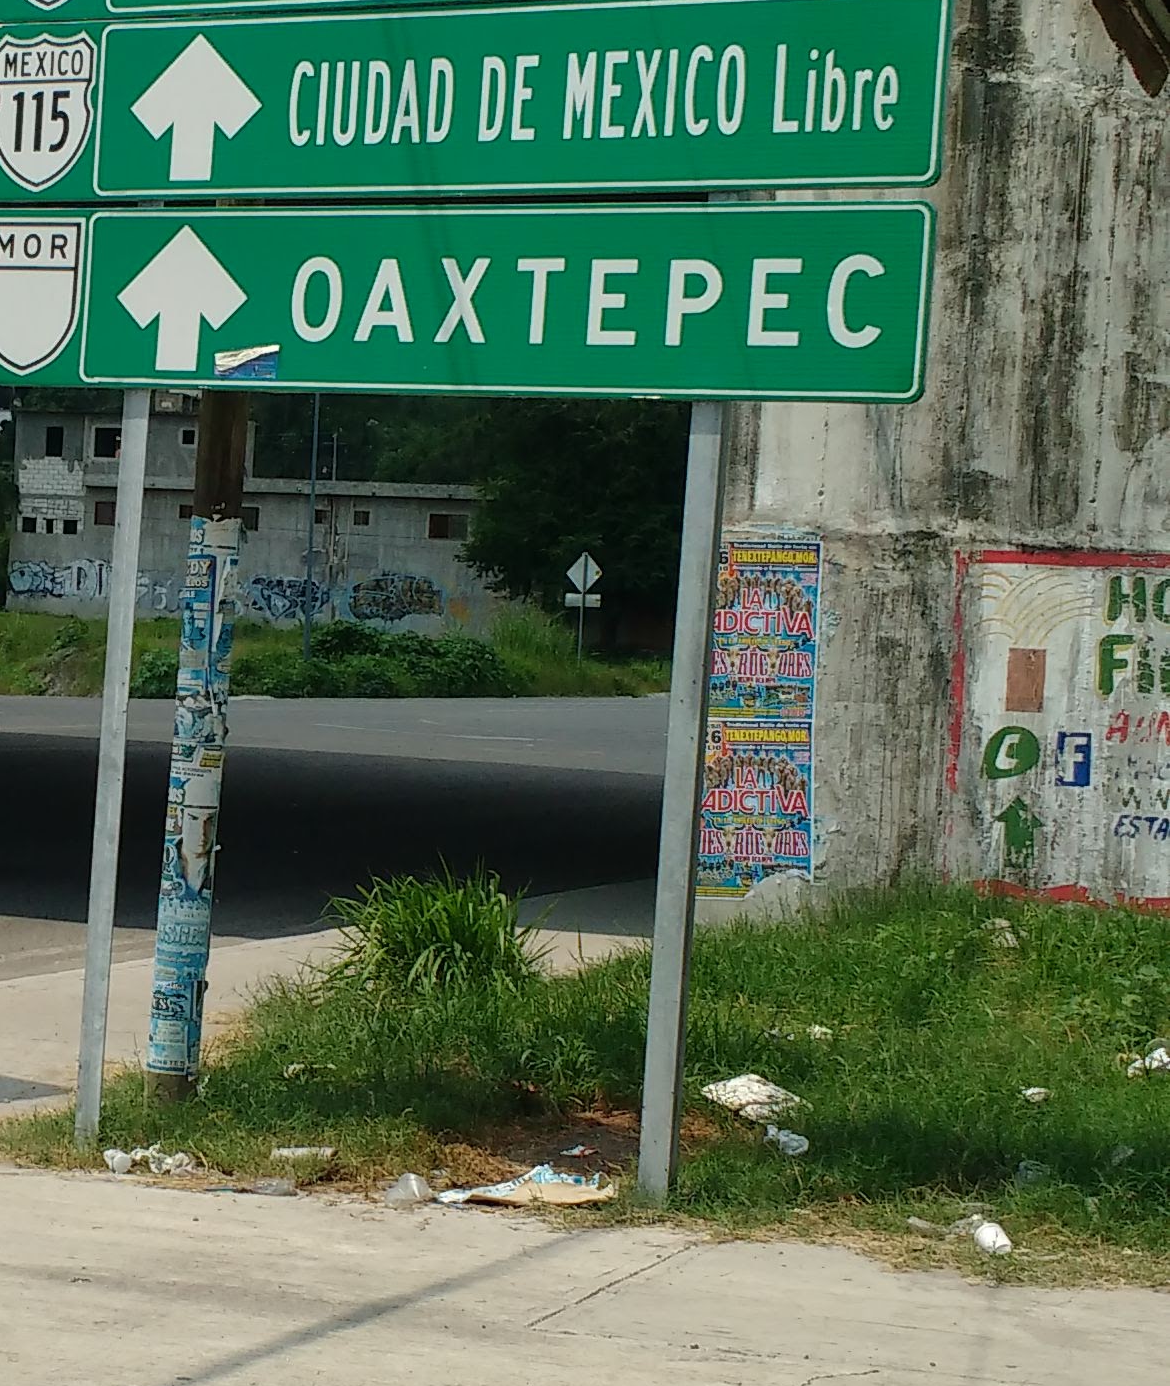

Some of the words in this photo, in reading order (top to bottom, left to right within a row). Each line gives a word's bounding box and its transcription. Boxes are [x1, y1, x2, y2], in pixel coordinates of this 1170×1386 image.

[3, 49, 85, 78] MEXICO
[288, 56, 455, 148] CIUDAD
[478, 54, 540, 144] DE
[562, 44, 747, 141] MEXICO
[772, 44, 899, 135] Libre
[12, 90, 71, 155] 115
[290, 253, 886, 350] OAXTEPEC
[741, 587, 763, 610] LA
[735, 767, 758, 789] LA
[701, 784, 809, 818] ADICTIVA
[1113, 814, 1170, 841] ESTA
